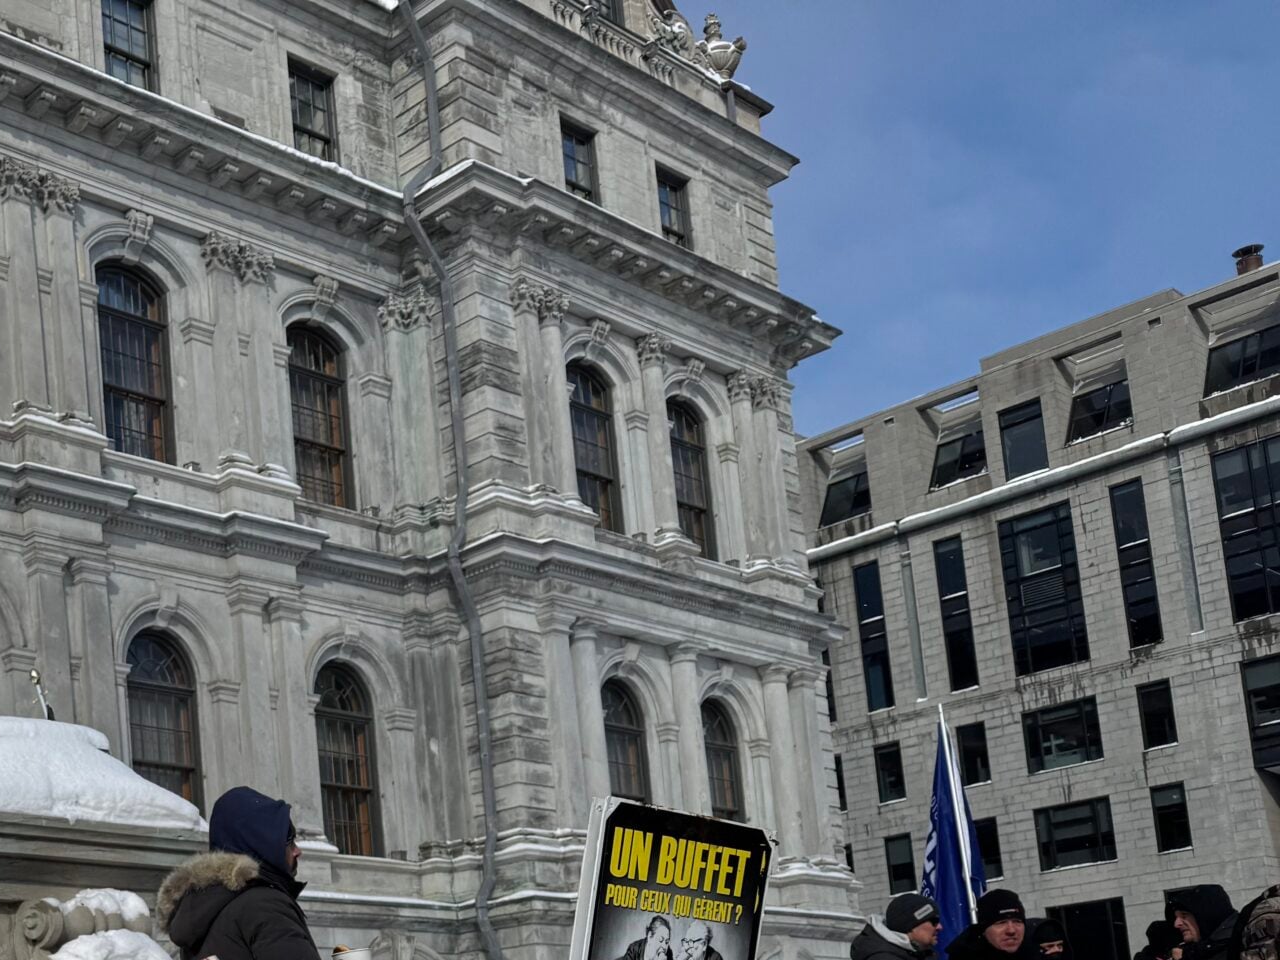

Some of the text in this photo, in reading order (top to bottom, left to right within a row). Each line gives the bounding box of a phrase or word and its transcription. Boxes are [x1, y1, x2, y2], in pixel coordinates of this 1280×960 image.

[610, 826, 752, 898] UN BUFFET
[604, 883, 638, 910] POUR
[640, 888, 672, 915] CEUX
[672, 894, 692, 919] QUI
